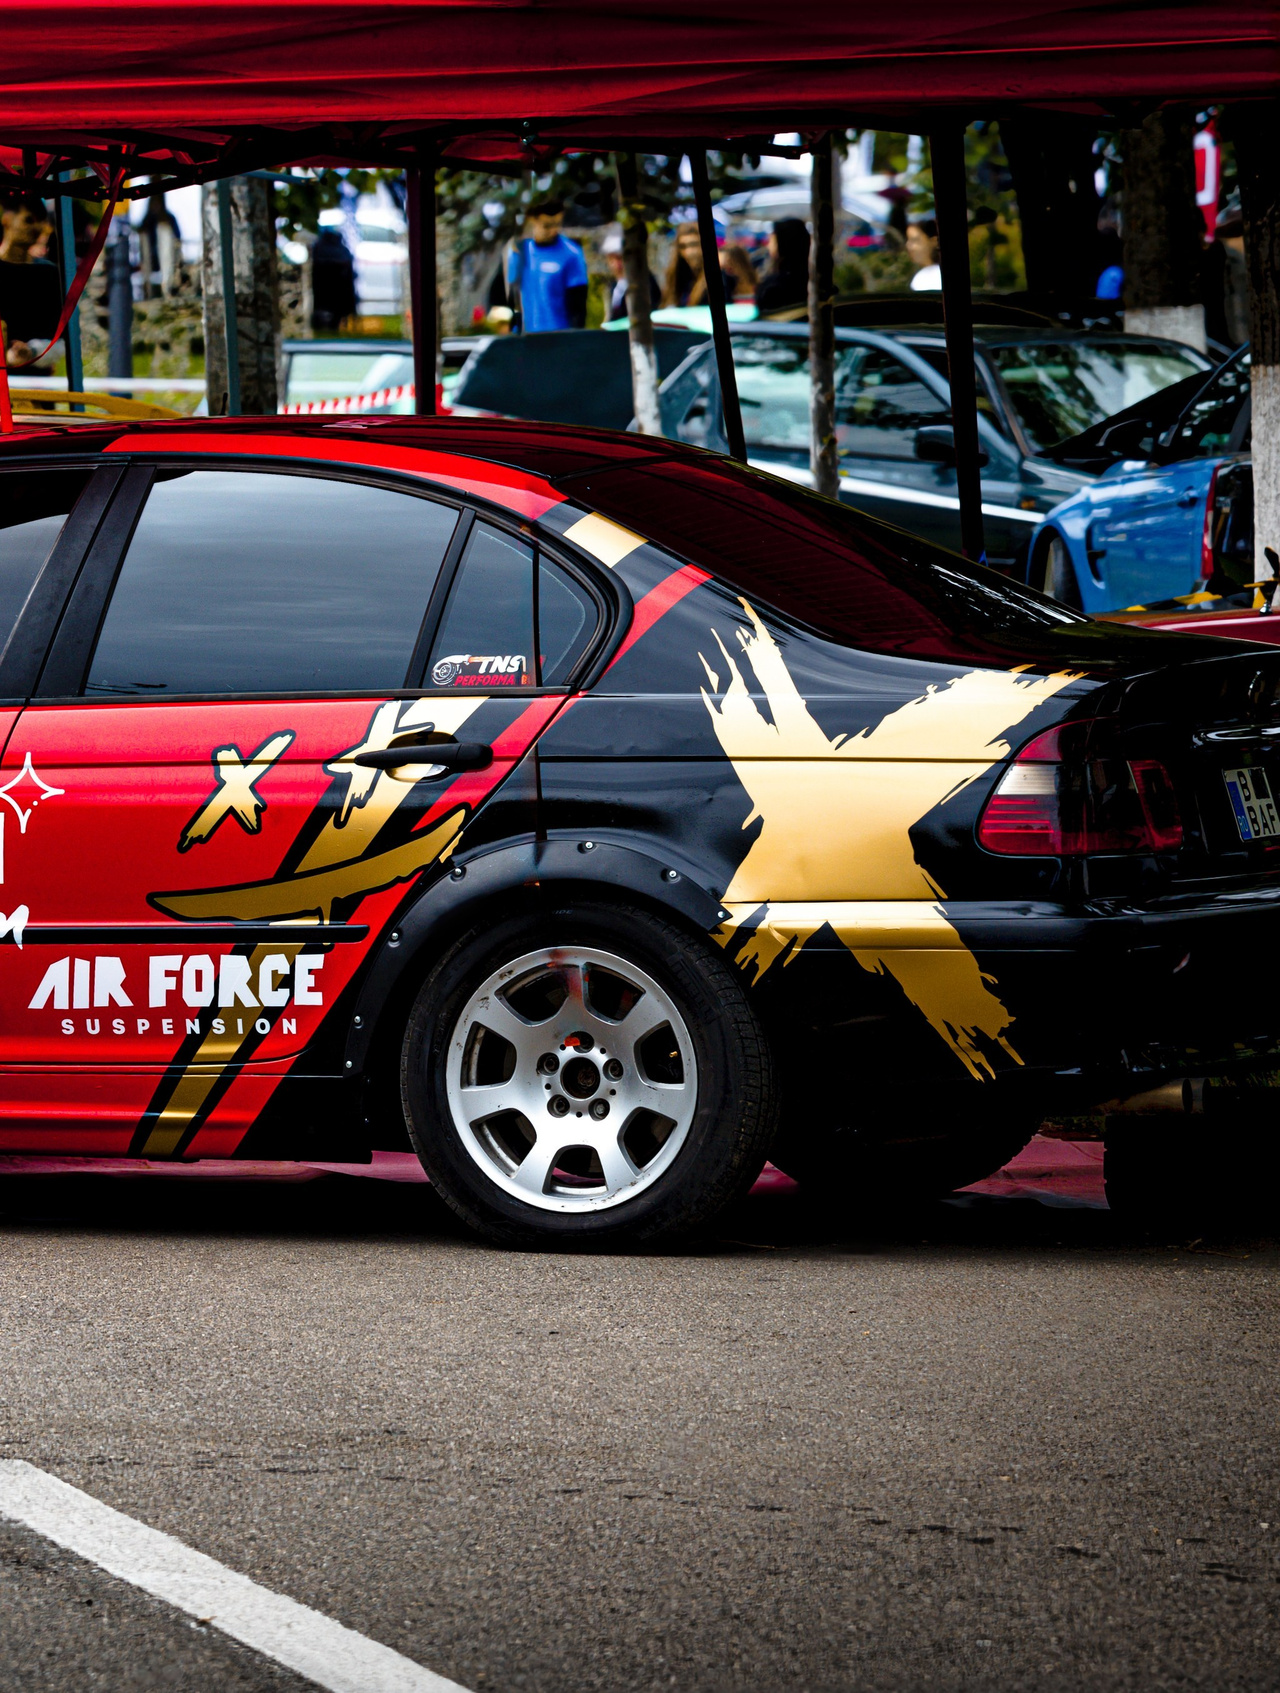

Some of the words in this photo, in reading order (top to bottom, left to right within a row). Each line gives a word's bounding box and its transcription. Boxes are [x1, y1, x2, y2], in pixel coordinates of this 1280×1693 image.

[478, 655, 524, 674] TNS
[454, 674, 527, 687] PERFORMA
[1237, 771, 1251, 801] B
[28, 956, 134, 1010] AIR
[148, 954, 326, 1008] FORCE
[61, 1017, 298, 1035] SUSPENSION
